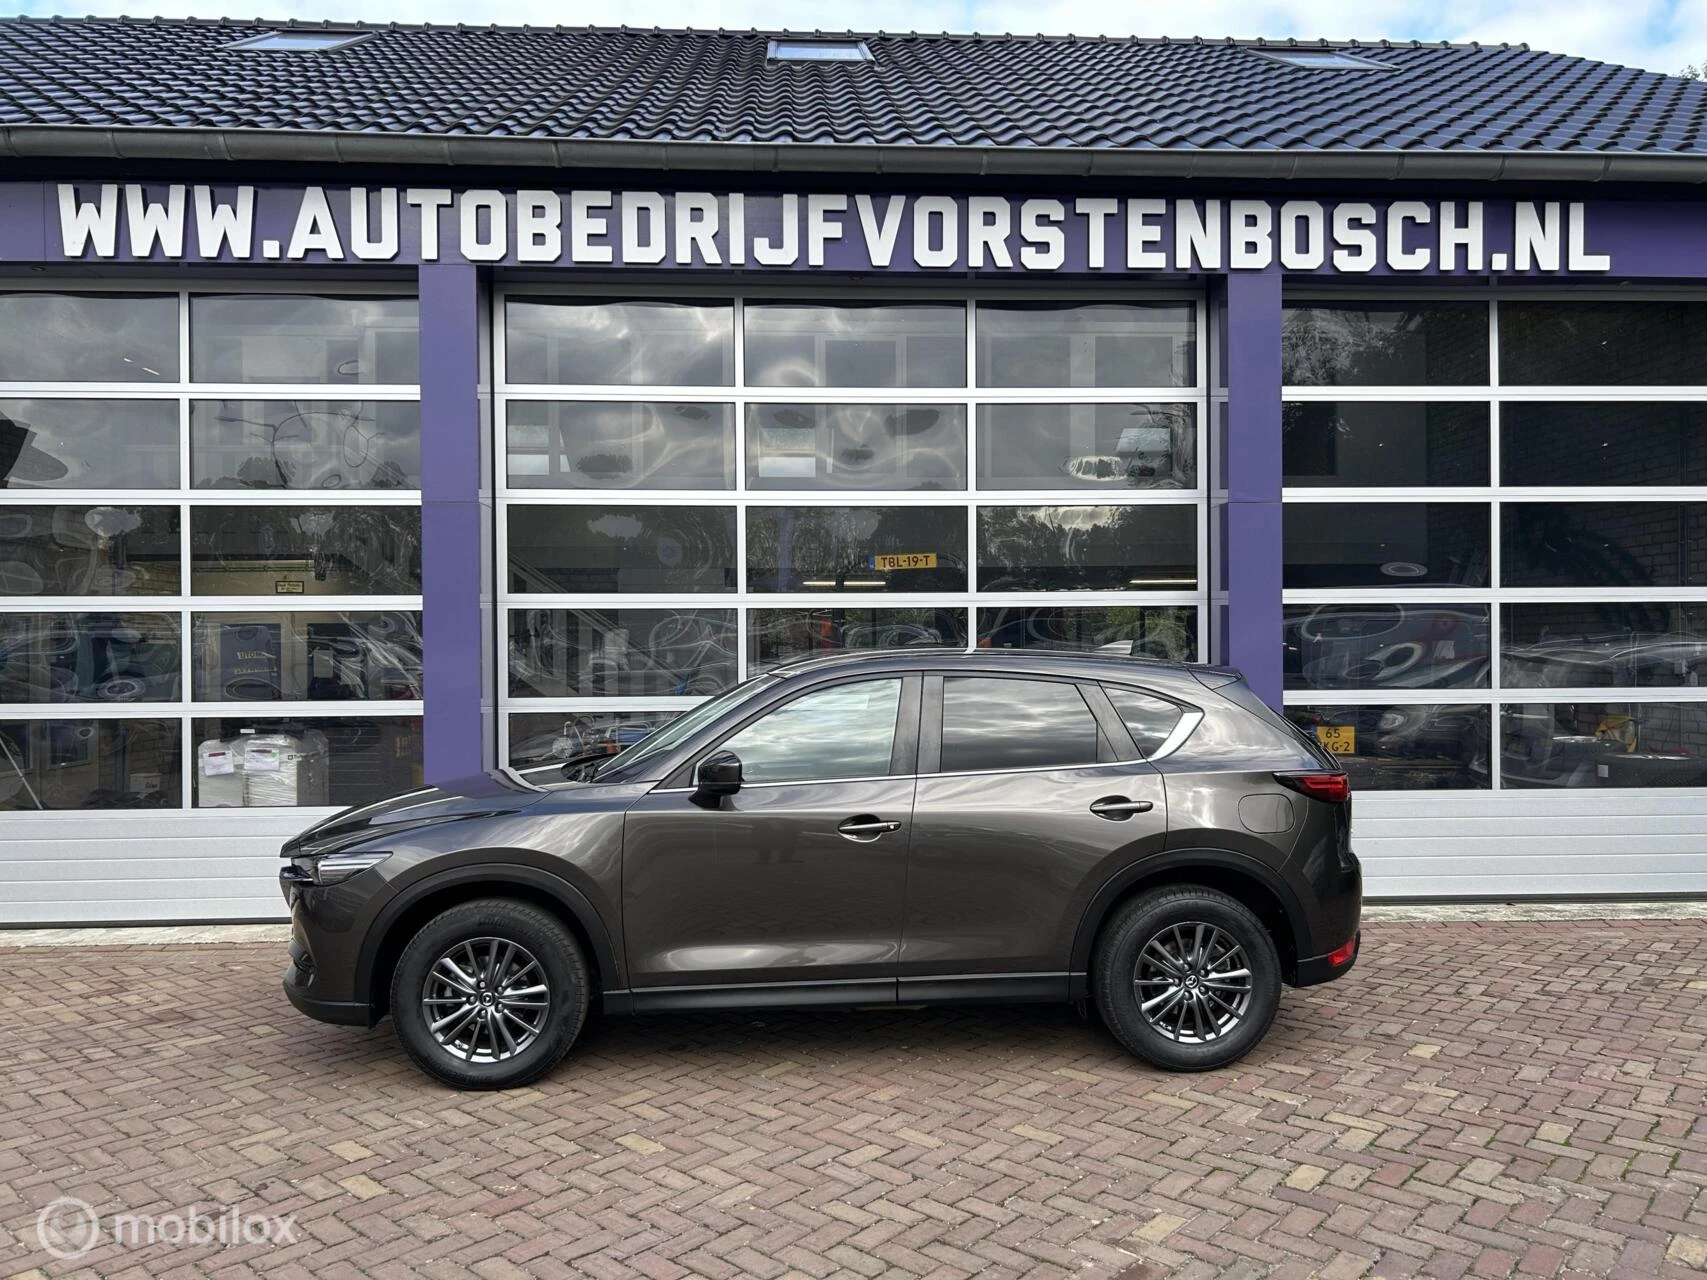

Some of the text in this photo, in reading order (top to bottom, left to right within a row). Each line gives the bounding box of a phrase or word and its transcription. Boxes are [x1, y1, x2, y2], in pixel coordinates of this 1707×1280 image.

[57, 183, 1611, 272] WWW.AUTOBEDRIJFVORSTENBOSCH.NL
[881, 555, 930, 568] TBL-19-T
[1326, 728, 1341, 739] 65
[1320, 741, 1350, 752] KG-2
